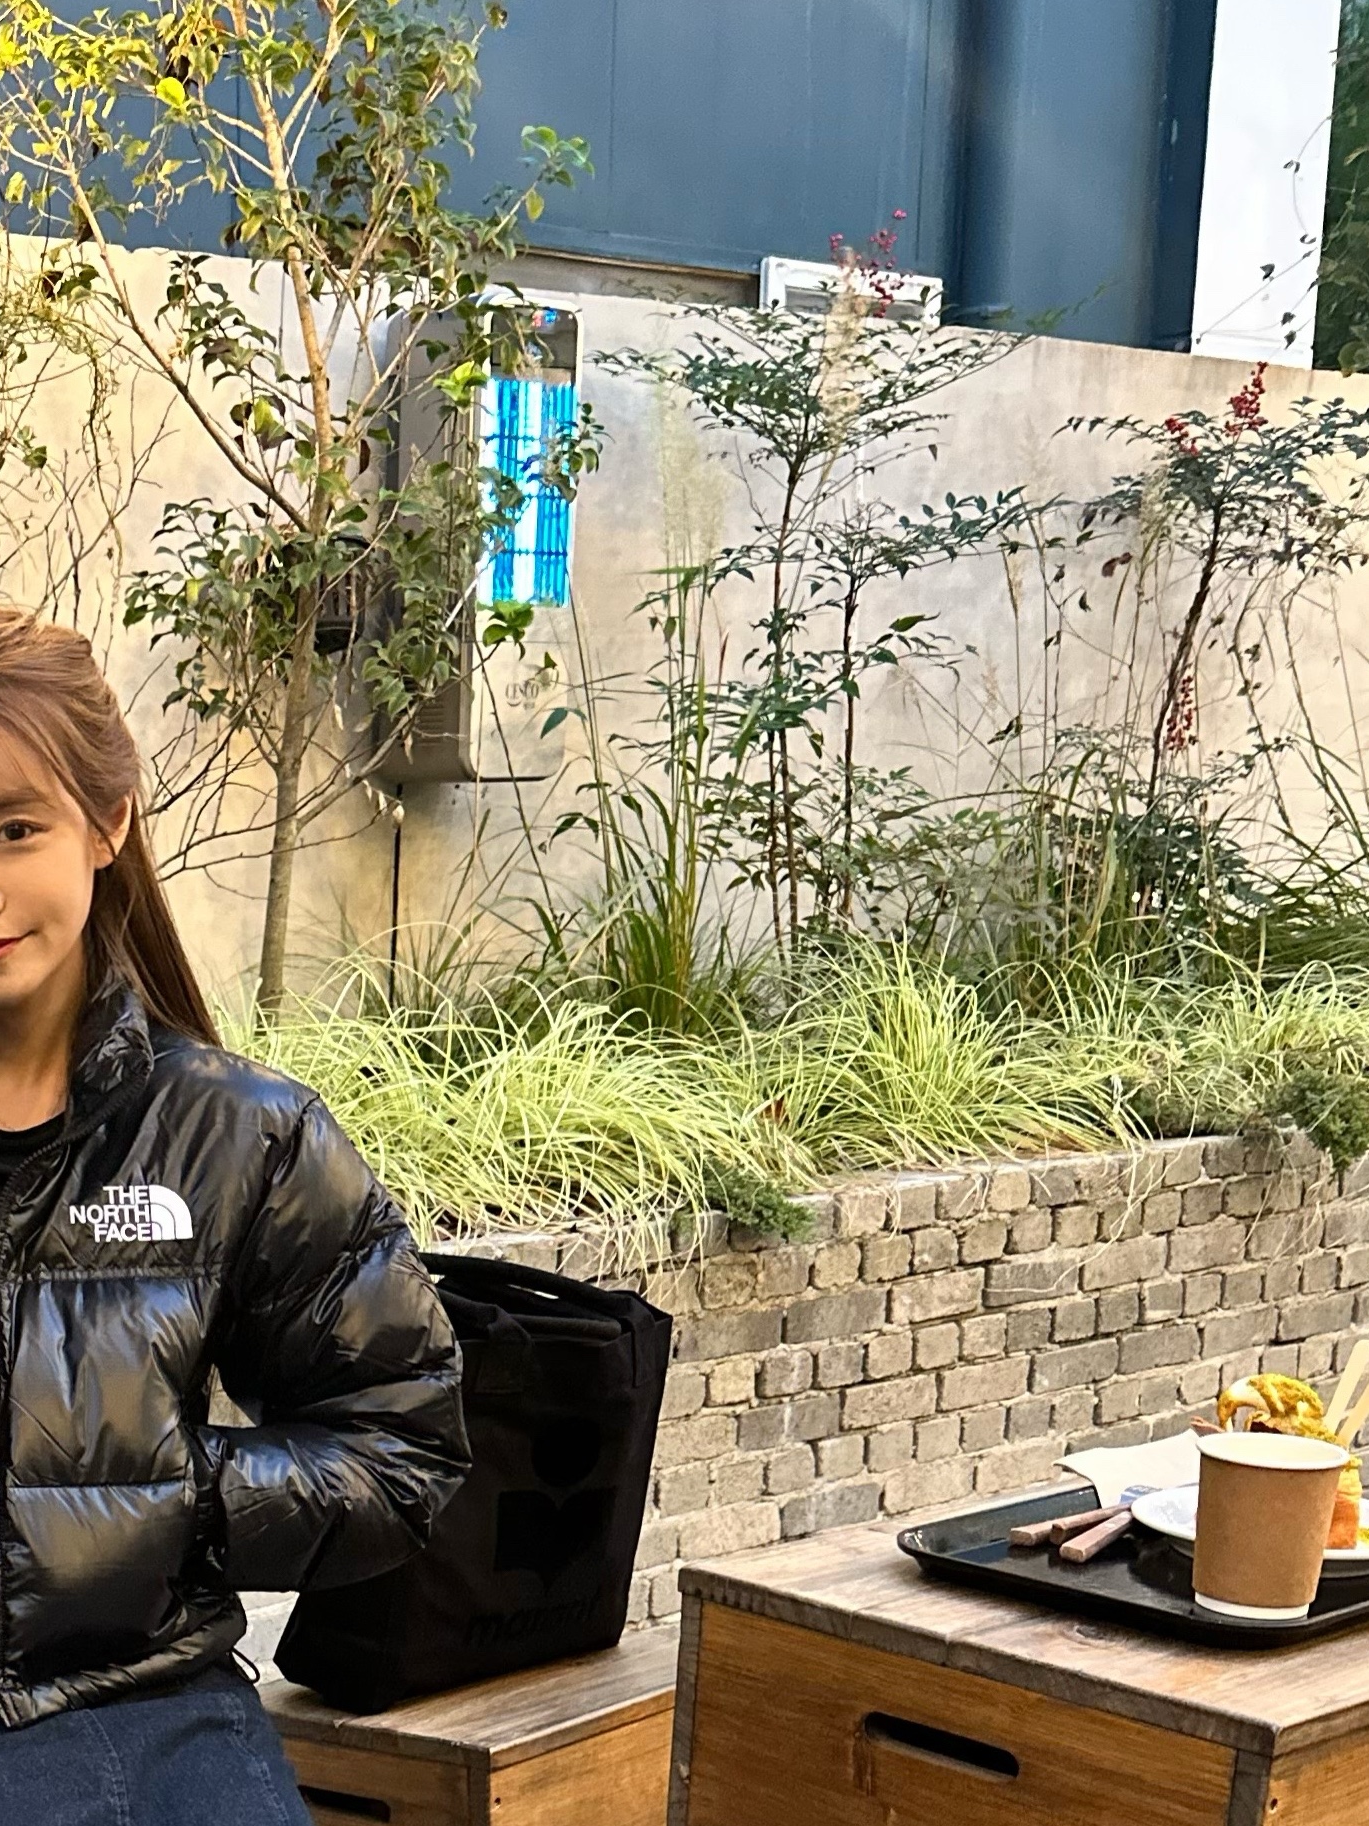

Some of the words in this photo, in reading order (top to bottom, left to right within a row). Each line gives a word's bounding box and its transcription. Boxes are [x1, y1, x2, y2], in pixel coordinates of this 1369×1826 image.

[103, 1185, 149, 1205] THE
[69, 1204, 150, 1224] NORTH
[94, 1223, 152, 1242] FACE
